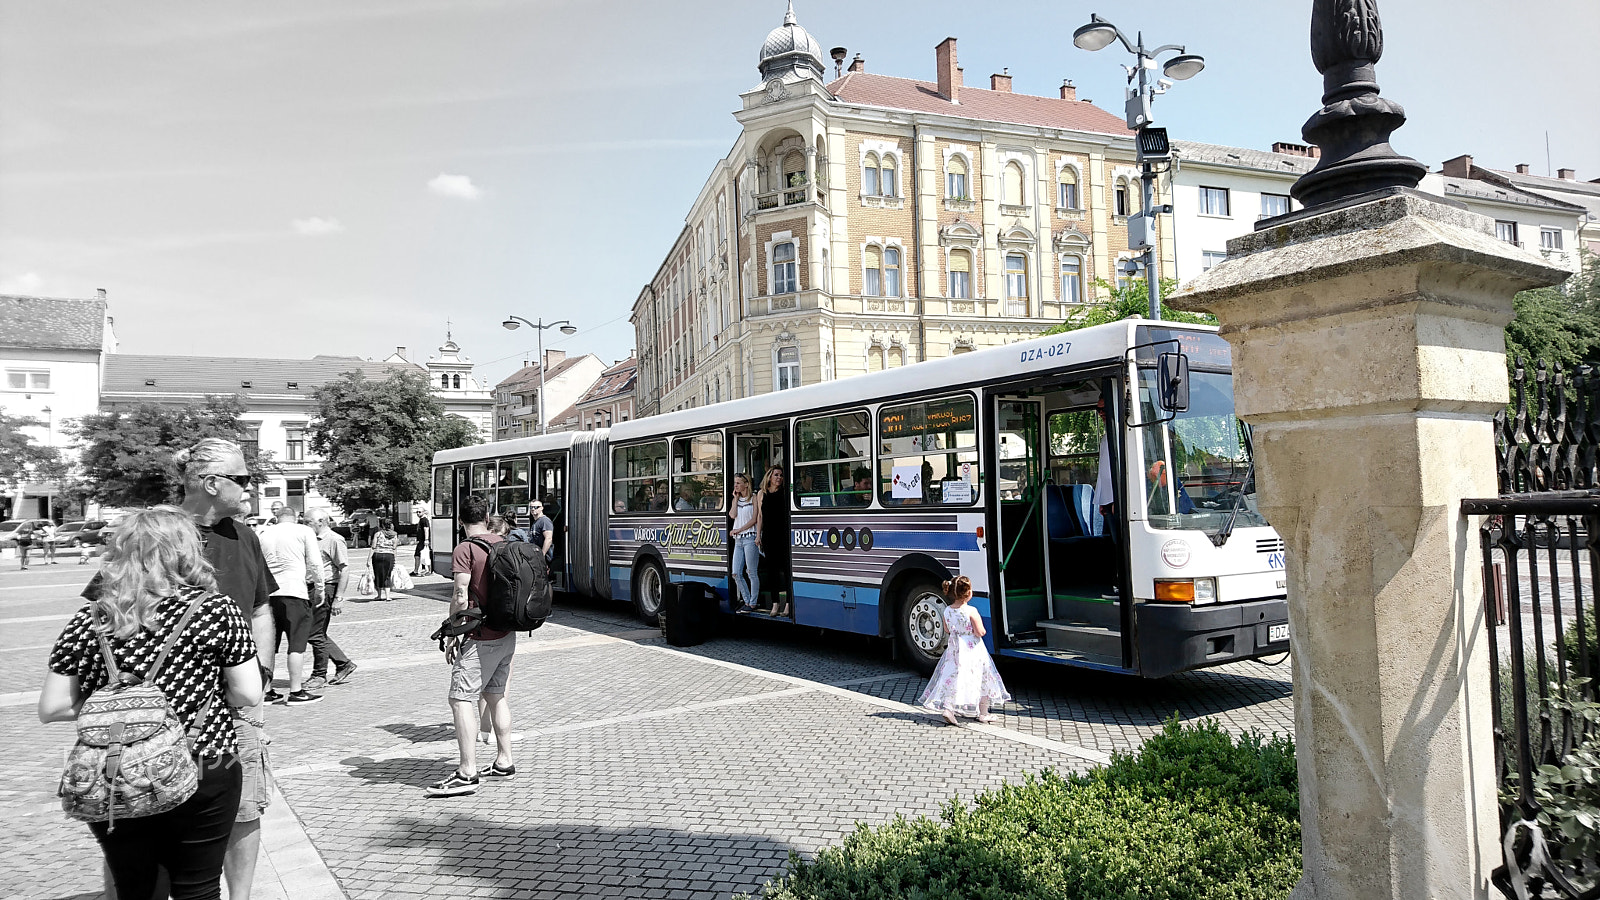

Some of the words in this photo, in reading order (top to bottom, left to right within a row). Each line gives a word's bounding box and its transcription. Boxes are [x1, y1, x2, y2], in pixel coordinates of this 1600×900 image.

[1020, 342, 1072, 363] DZA-027
[633, 525, 657, 541] VÁROSI
[660, 518, 722, 555] Kult-Tour
[794, 529, 824, 546] BUSZ
